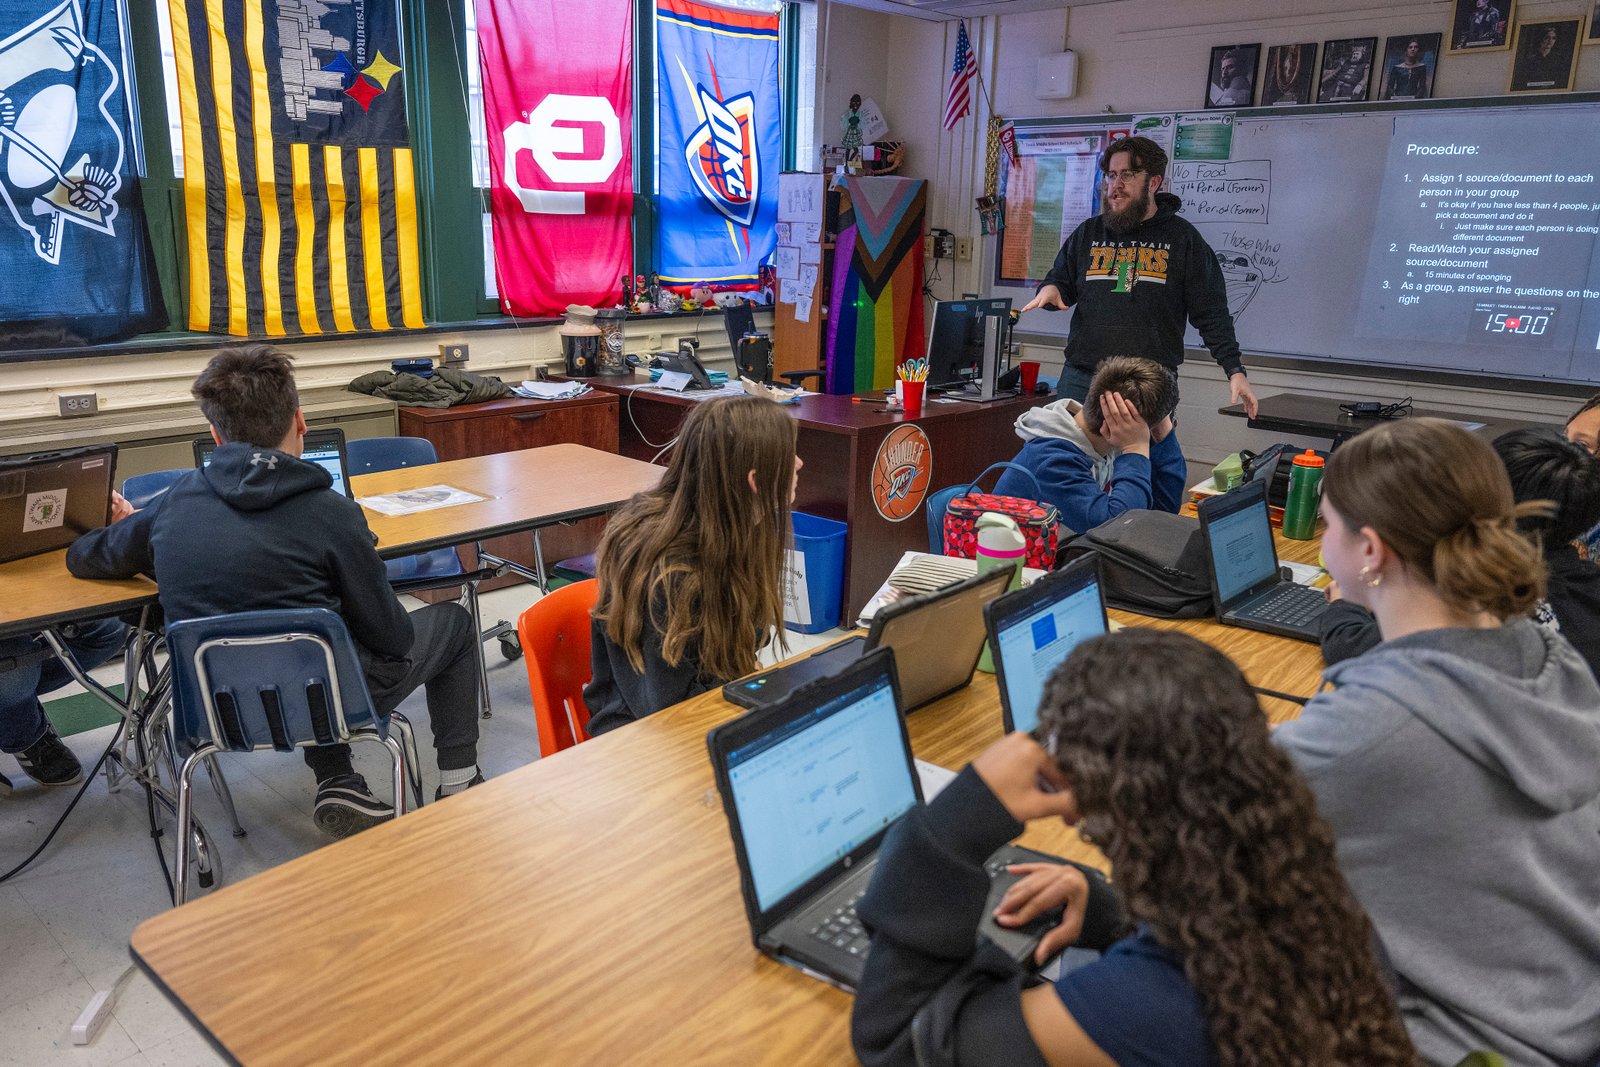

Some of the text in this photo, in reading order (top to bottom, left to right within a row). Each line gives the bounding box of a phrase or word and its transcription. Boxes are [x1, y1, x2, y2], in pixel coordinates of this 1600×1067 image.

[700, 89, 747, 199] OKC
[1406, 143, 1480, 156] Procedure:
[1174, 164, 1227, 178] No Food
[1403, 173, 1594, 185] 1. Assign 1 source/document to each
[1197, 181, 1225, 194] Period
[1227, 182, 1265, 194] (Forever)
[1418, 187, 1520, 199] person in your group
[1198, 201, 1229, 214] Period
[1450, 201, 1469, 209] okay
[1477, 202, 1492, 210] you
[1493, 201, 1513, 209] have
[1514, 201, 1531, 209] less
[1532, 201, 1551, 210] than
[1559, 202, 1591, 211] people,
[1459, 212, 1498, 220] document
[1499, 212, 1515, 220] and
[1472, 223, 1494, 231] make
[1536, 225, 1565, 233] person
[1566, 224, 1574, 232] is
[1575, 224, 1599, 234] doing
[1222, 230, 1281, 253] Those Who
[1452, 233, 1525, 242] different document
[1091, 240, 1171, 250] MARK TWAIN
[1389, 243, 1540, 257] 2. Read/Watch your assigned
[1405, 258, 1489, 268] source/document
[1466, 272, 1476, 280] of
[1476, 273, 1512, 282] sponging
[1382, 280, 1392, 289] 3.
[1400, 281, 1414, 290] As
[1424, 283, 1455, 293] group,
[1457, 285, 1494, 293] answer
[1495, 285, 1512, 293] the
[1514, 286, 1564, 296] questions
[1566, 290, 1580, 298] on
[1582, 288, 1600, 299] the
[1398, 295, 1420, 305] right
[882, 441, 925, 470] THUNDER
